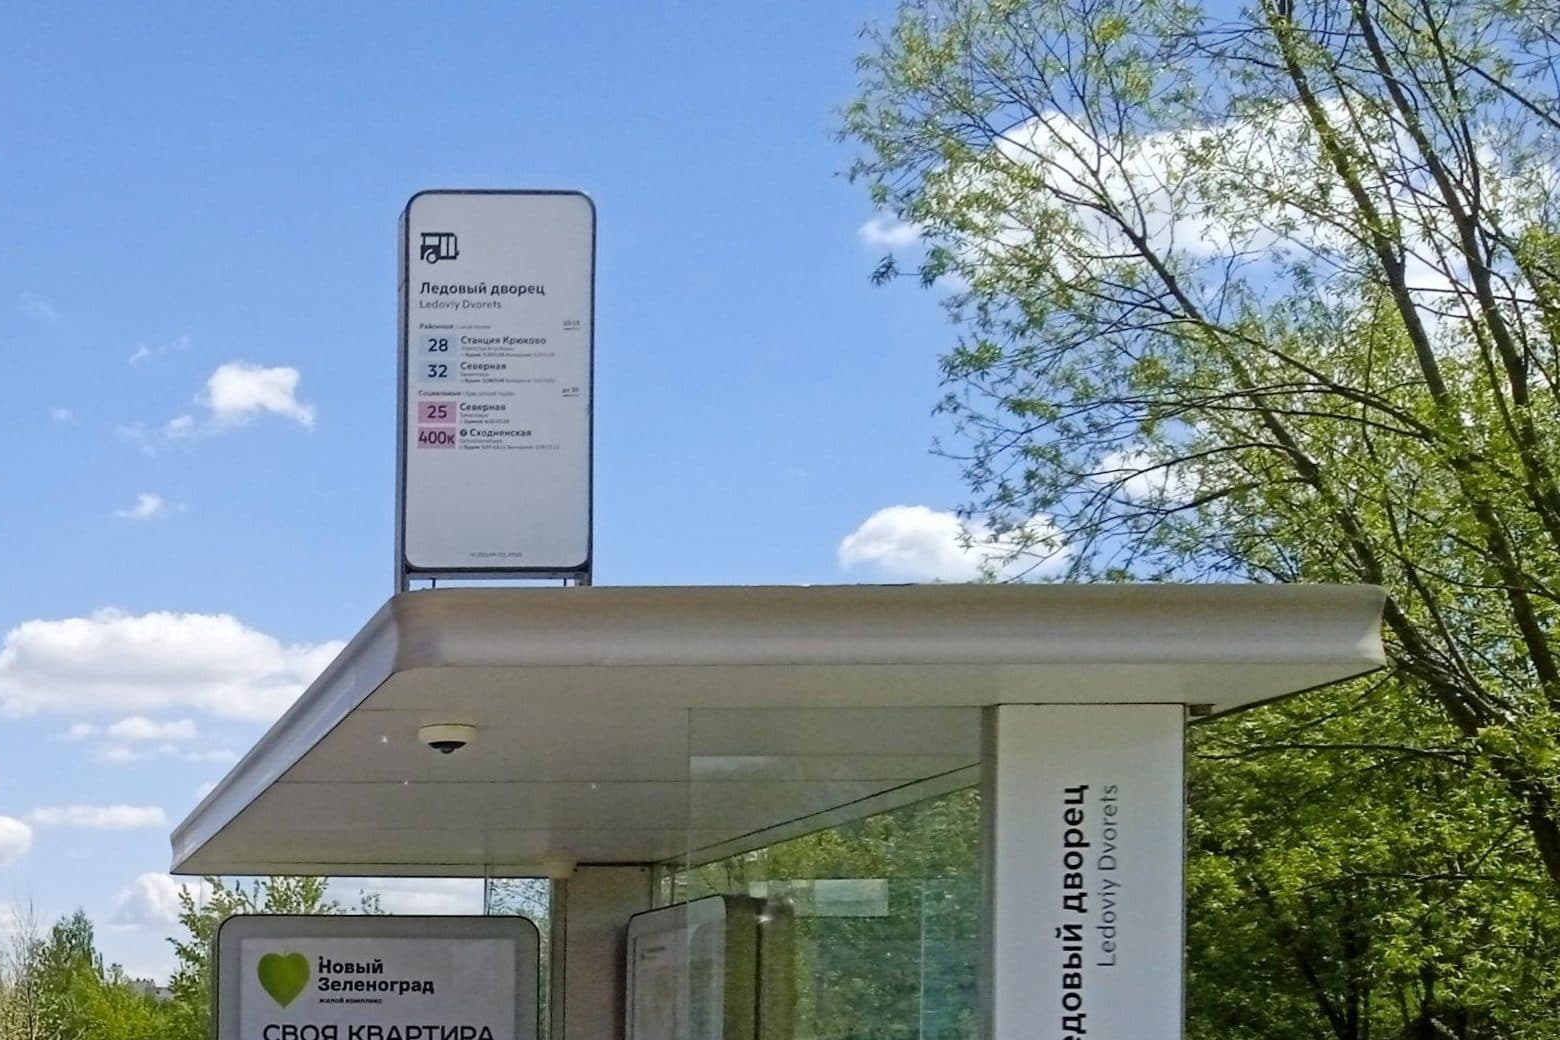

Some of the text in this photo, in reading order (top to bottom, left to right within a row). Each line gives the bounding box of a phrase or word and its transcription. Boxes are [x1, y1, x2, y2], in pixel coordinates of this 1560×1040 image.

[420, 282, 545, 296] Ледовый дворец
[419, 301, 502, 310] Ledoviy Dvorets
[428, 338, 448, 352] 28
[460, 335, 546, 346] Станция Крюково
[427, 364, 448, 378] 32
[460, 362, 507, 371] Северная
[427, 405, 448, 419] 25
[459, 403, 506, 412] Северная
[470, 430, 532, 438] Сходненская
[1062, 784, 1091, 914] дворец
[1095, 783, 1121, 967] Ledoviy Dvorets
[318, 956, 384, 974] Новый
[318, 977, 435, 995] Зеленоград
